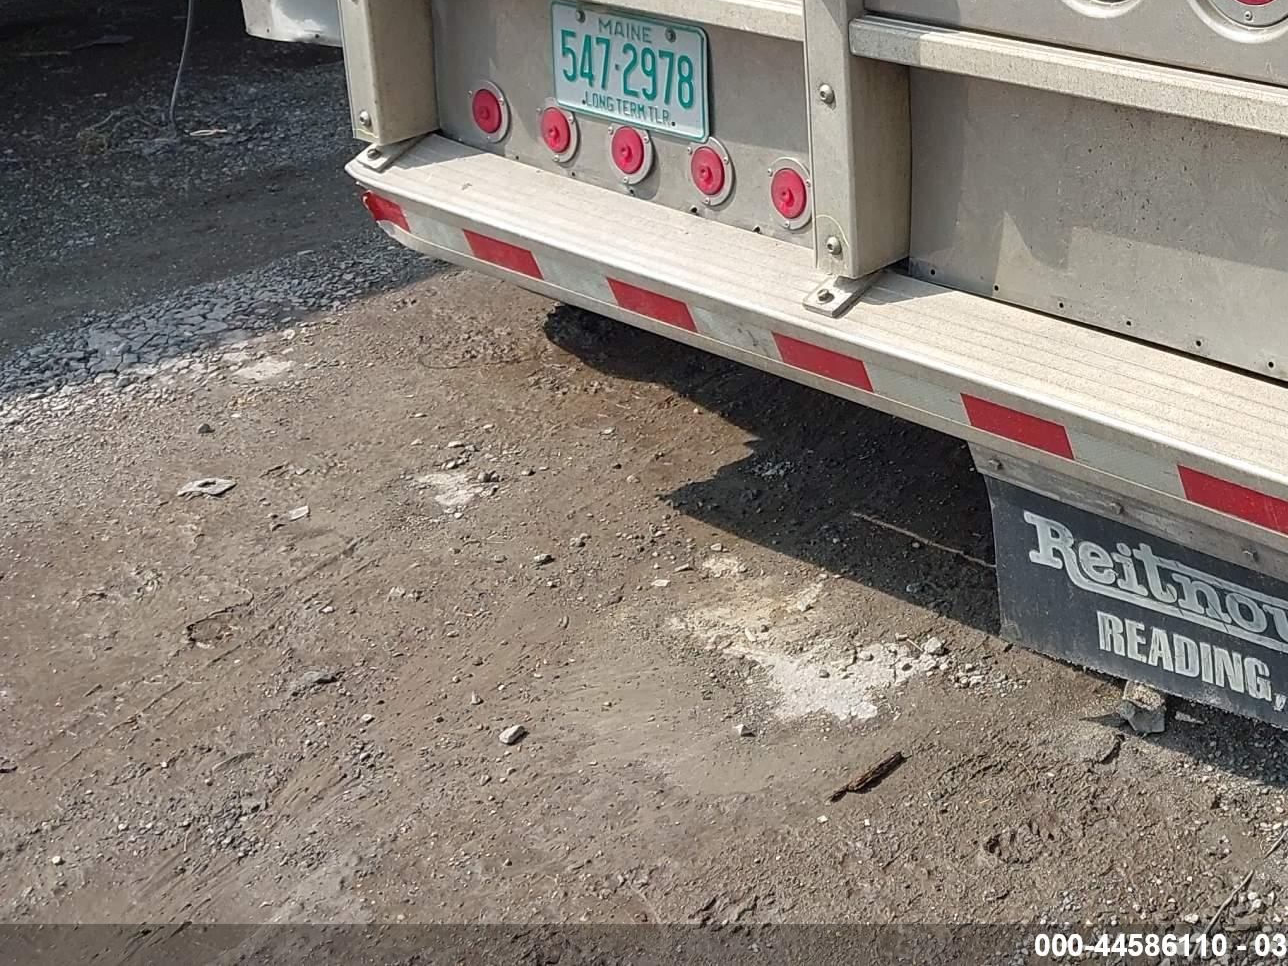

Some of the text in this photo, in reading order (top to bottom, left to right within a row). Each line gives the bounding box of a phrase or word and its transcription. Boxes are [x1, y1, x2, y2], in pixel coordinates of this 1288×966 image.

[598, 18, 653, 44] MAINE
[584, 91, 614, 113] LONG
[616, 99, 645, 119] TERM
[1096, 610, 1288, 713] READING,
